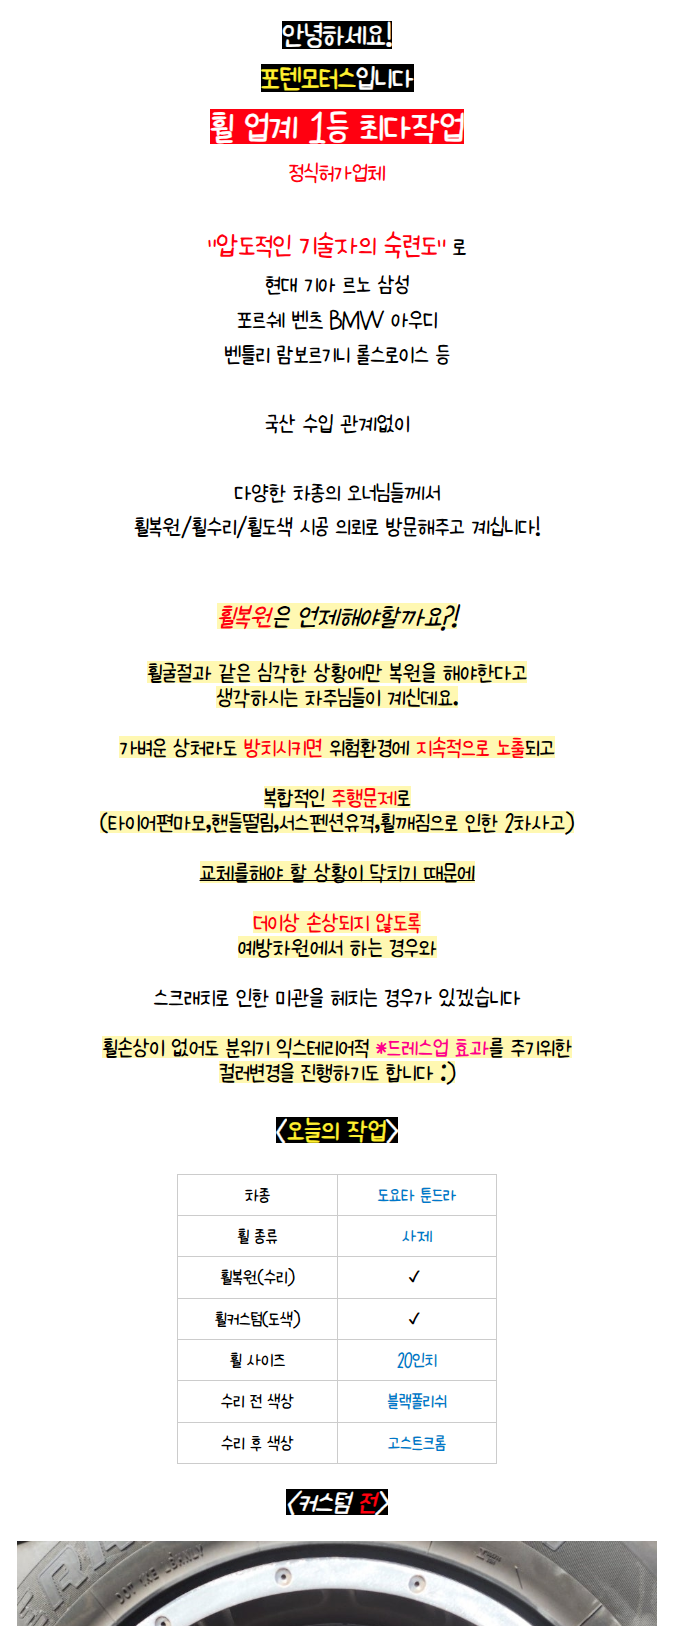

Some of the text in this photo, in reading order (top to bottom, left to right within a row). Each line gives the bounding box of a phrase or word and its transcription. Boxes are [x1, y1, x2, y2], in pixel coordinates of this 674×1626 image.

[245, 1188, 270, 1203] 차종
[378, 1188, 456, 1203] 도요타 툰드라
[220, 1268, 295, 1287] 휠복원(수리)
[397, 1352, 437, 1368] 20인치
[221, 1393, 294, 1409] 수리 전 색상
[388, 1393, 447, 1409] 블랙폴리쉬
[388, 1435, 446, 1451] 고스트크롬
